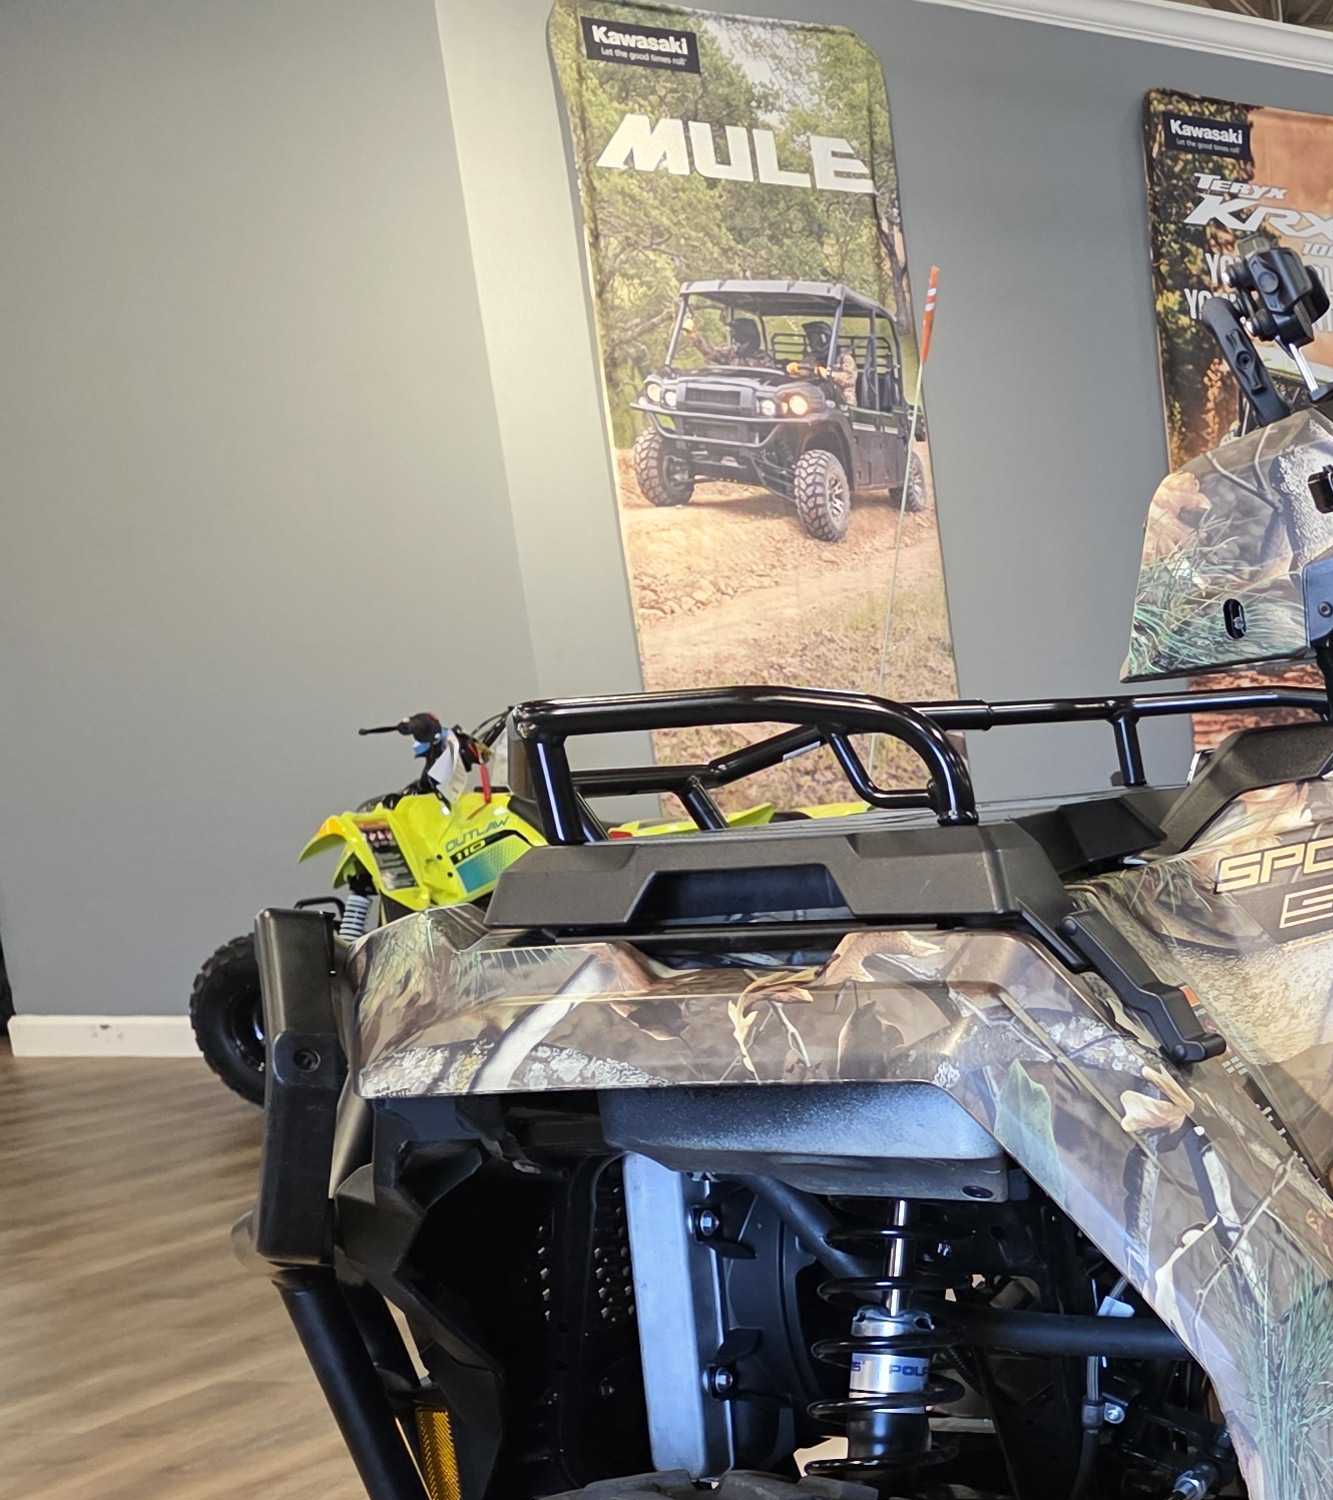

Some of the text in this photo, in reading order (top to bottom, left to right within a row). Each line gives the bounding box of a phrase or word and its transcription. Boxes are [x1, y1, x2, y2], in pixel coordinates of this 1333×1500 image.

[592, 24, 688, 55] Kawasaki
[1170, 119, 1243, 144] Kawasaki
[595, 112, 877, 195] MULE
[445, 816, 510, 852] OUTLAW
